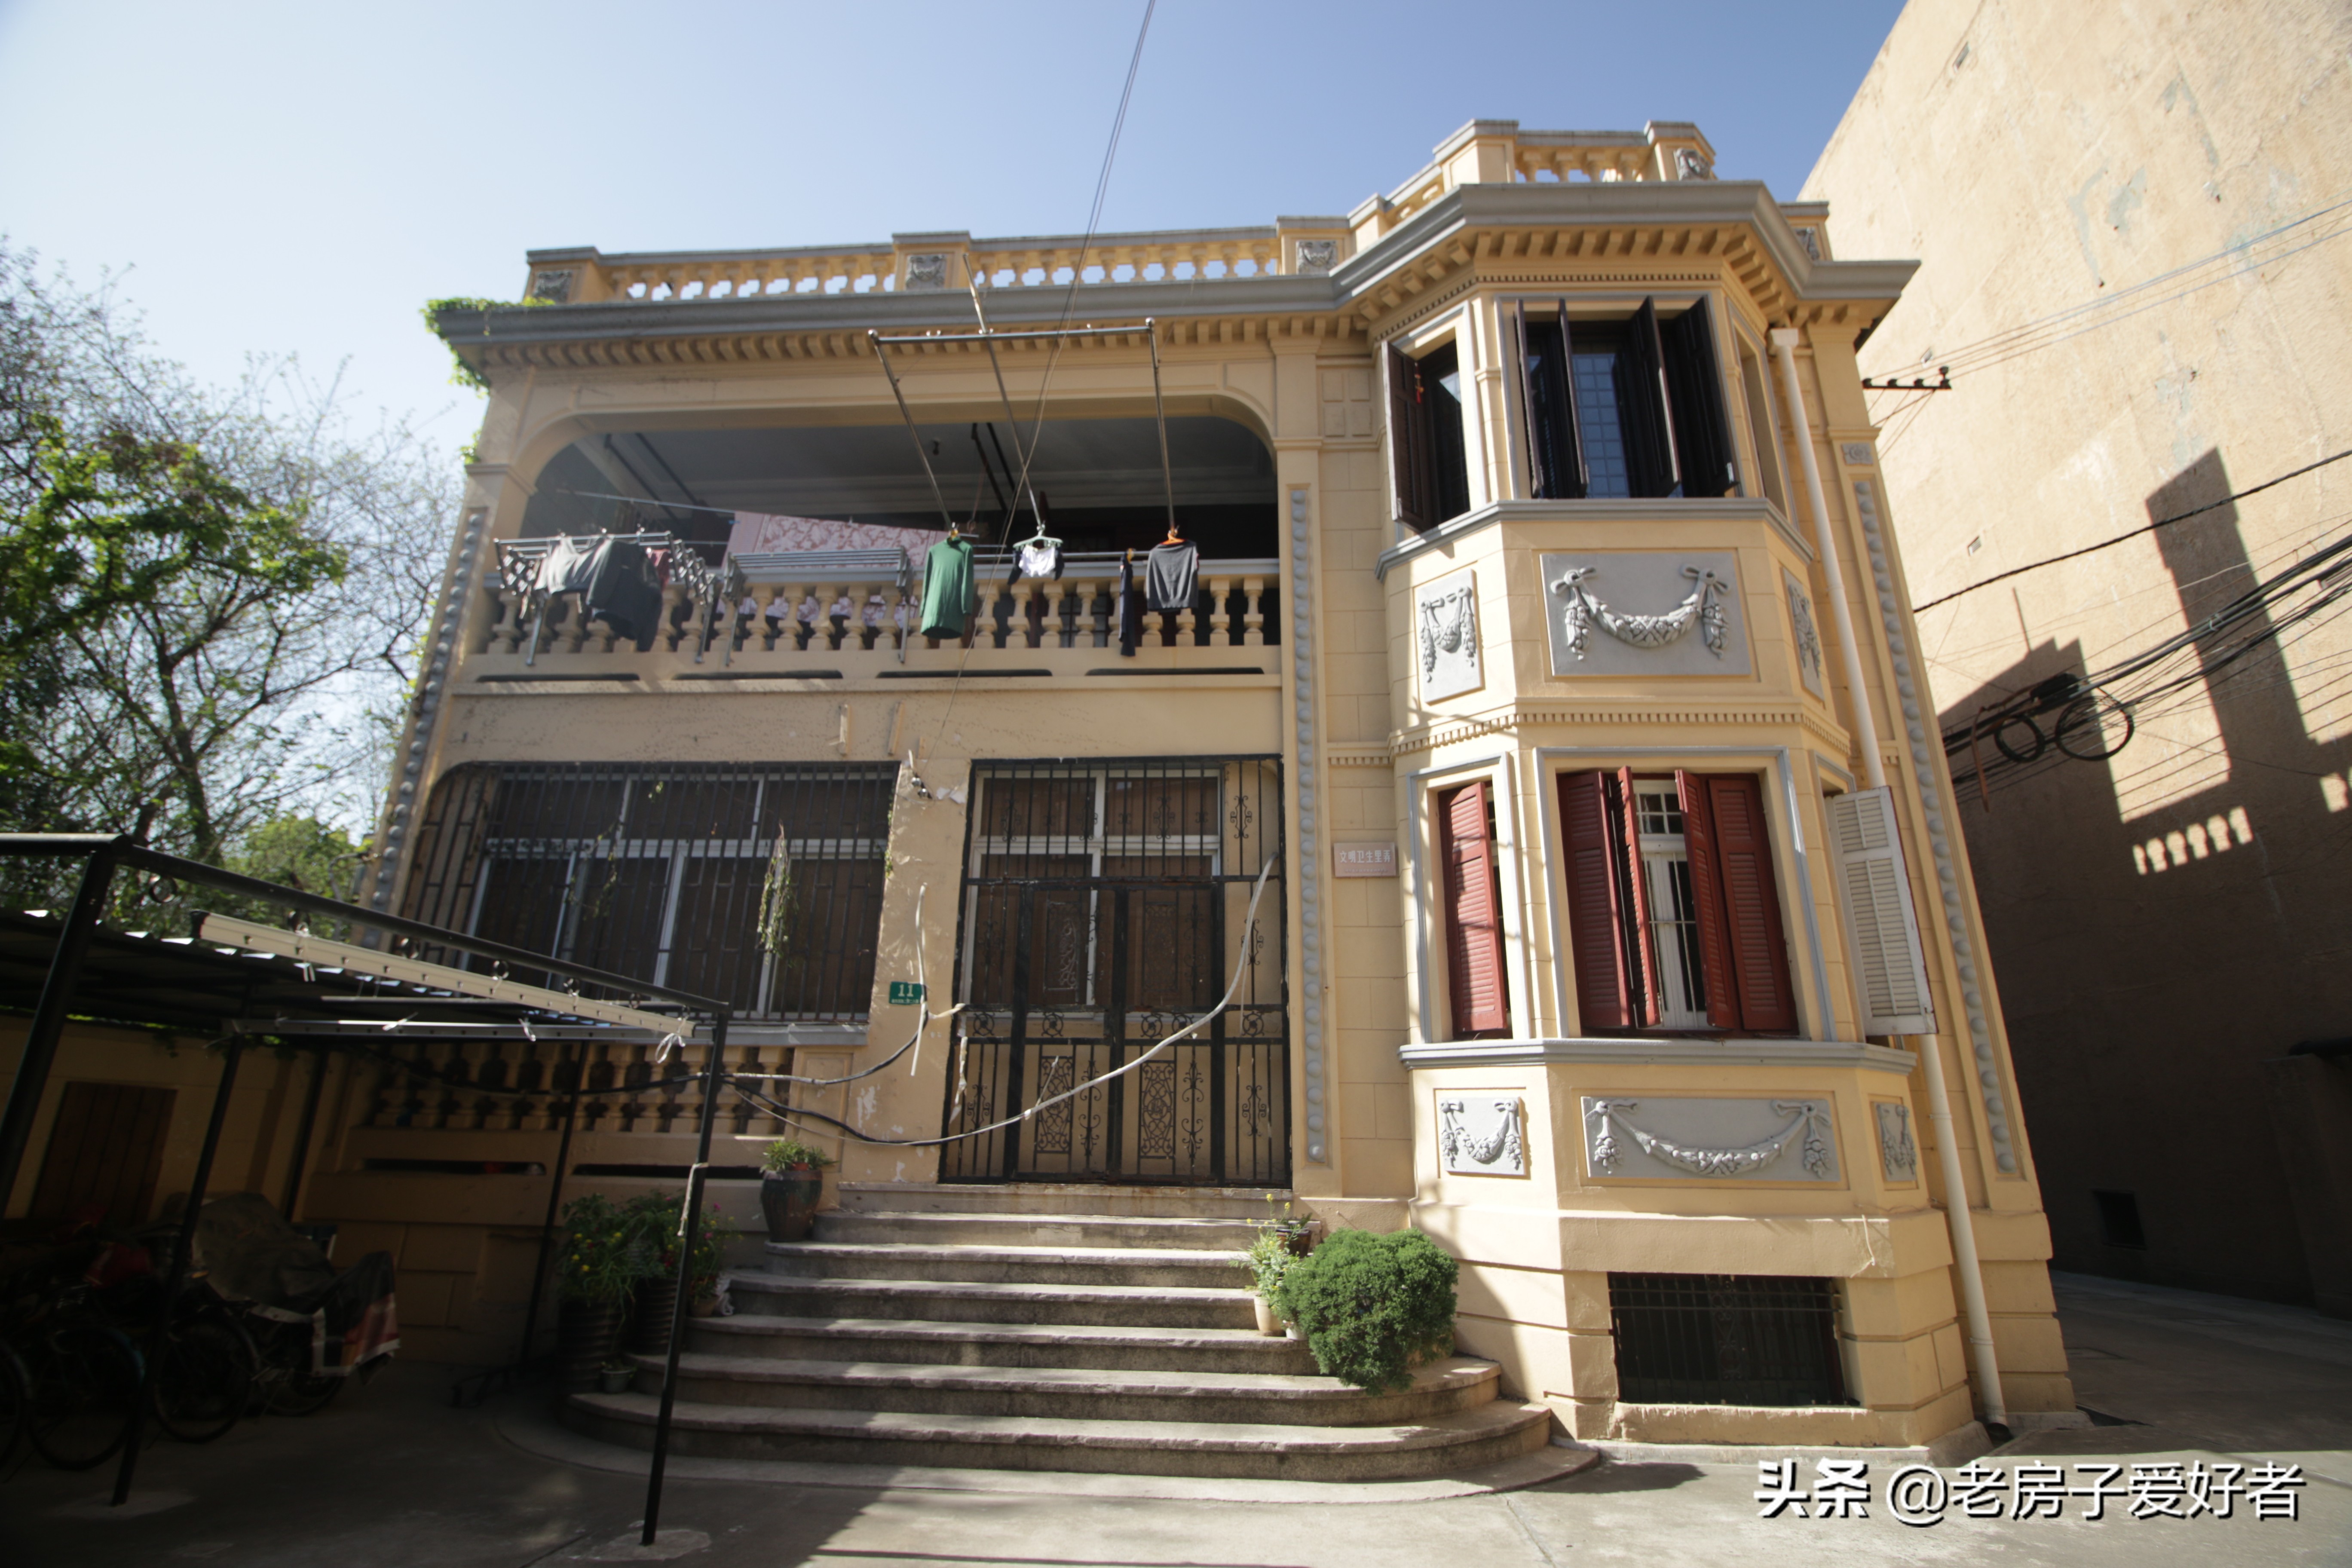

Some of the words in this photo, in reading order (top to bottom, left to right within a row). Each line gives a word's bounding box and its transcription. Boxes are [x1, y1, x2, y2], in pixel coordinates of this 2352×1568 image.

[1339, 849, 1391, 863] 文明卫生里弄
[898, 984, 914, 997] 11
